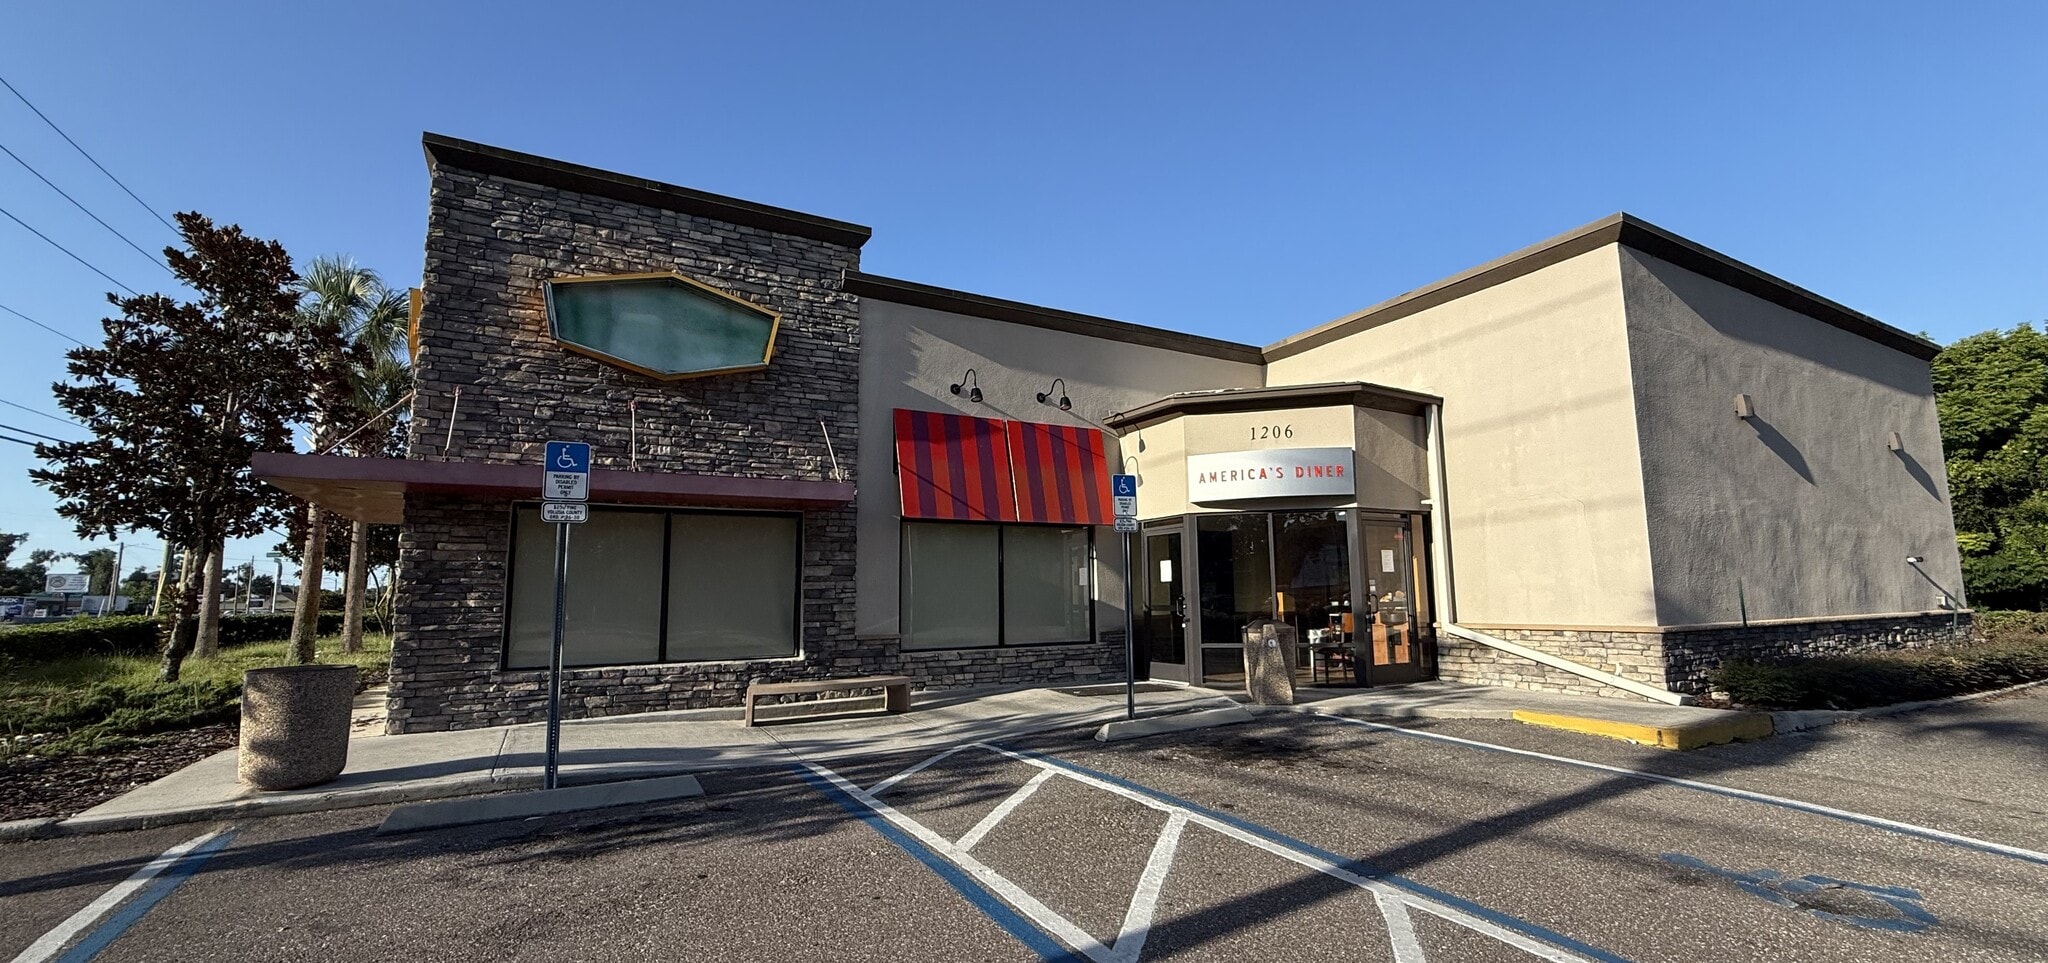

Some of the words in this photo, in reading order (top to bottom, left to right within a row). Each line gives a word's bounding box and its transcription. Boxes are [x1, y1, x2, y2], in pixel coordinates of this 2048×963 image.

[1250, 424, 1293, 441] 1206
[1199, 466, 1284, 484] AMERICA'S
[1295, 465, 1344, 479] DINER
